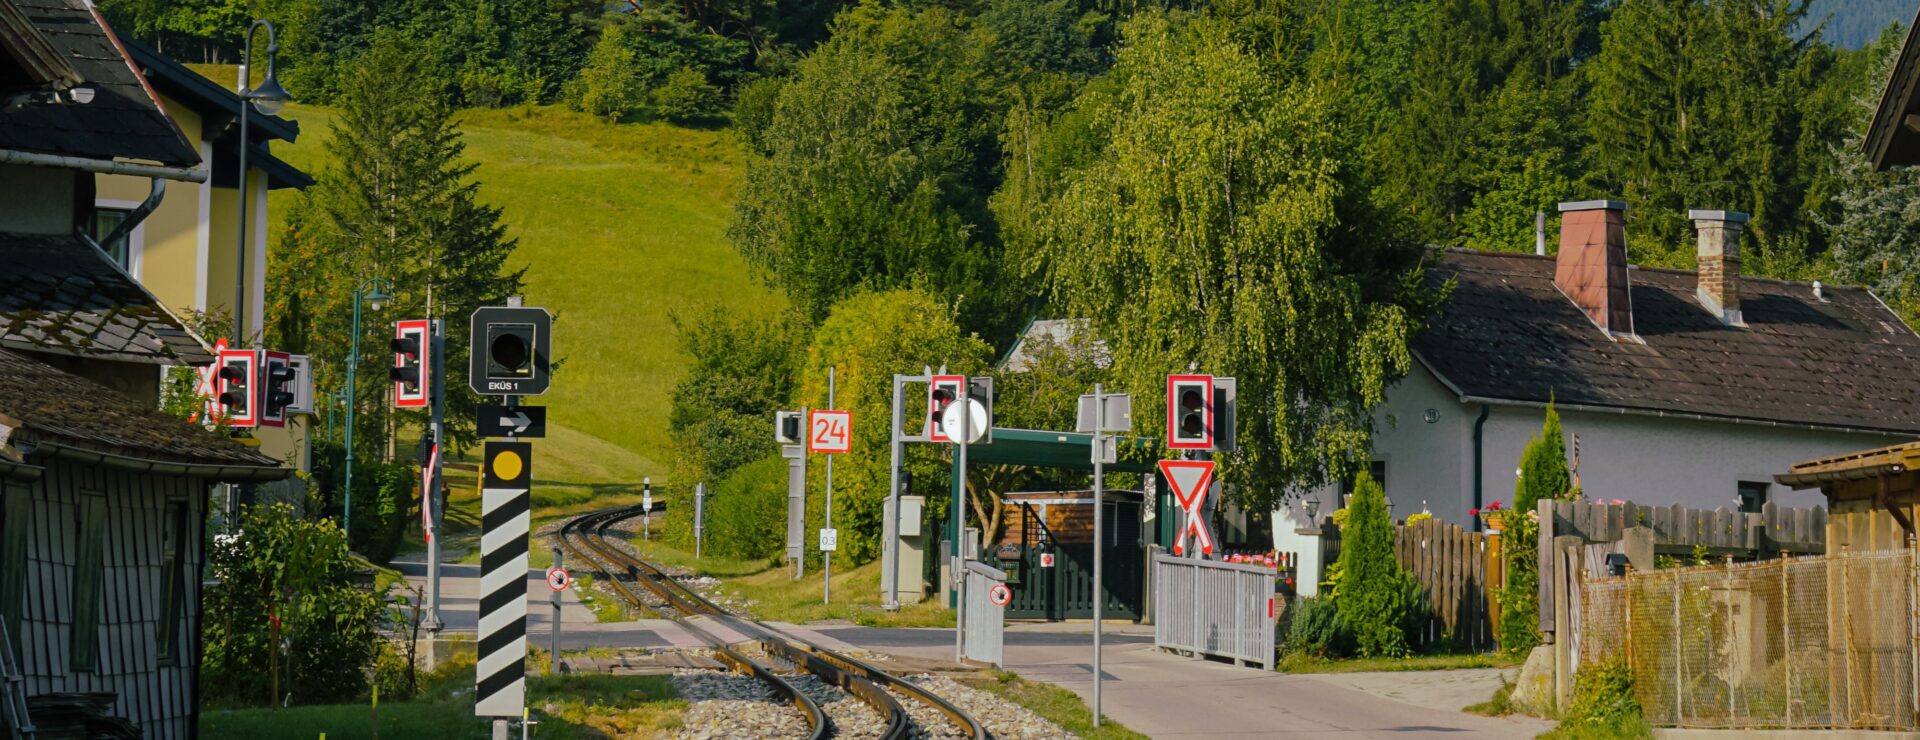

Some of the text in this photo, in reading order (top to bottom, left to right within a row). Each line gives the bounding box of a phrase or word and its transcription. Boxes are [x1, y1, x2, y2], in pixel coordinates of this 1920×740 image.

[488, 380, 518, 390] EKÜS 1
[815, 418, 845, 444] 24
